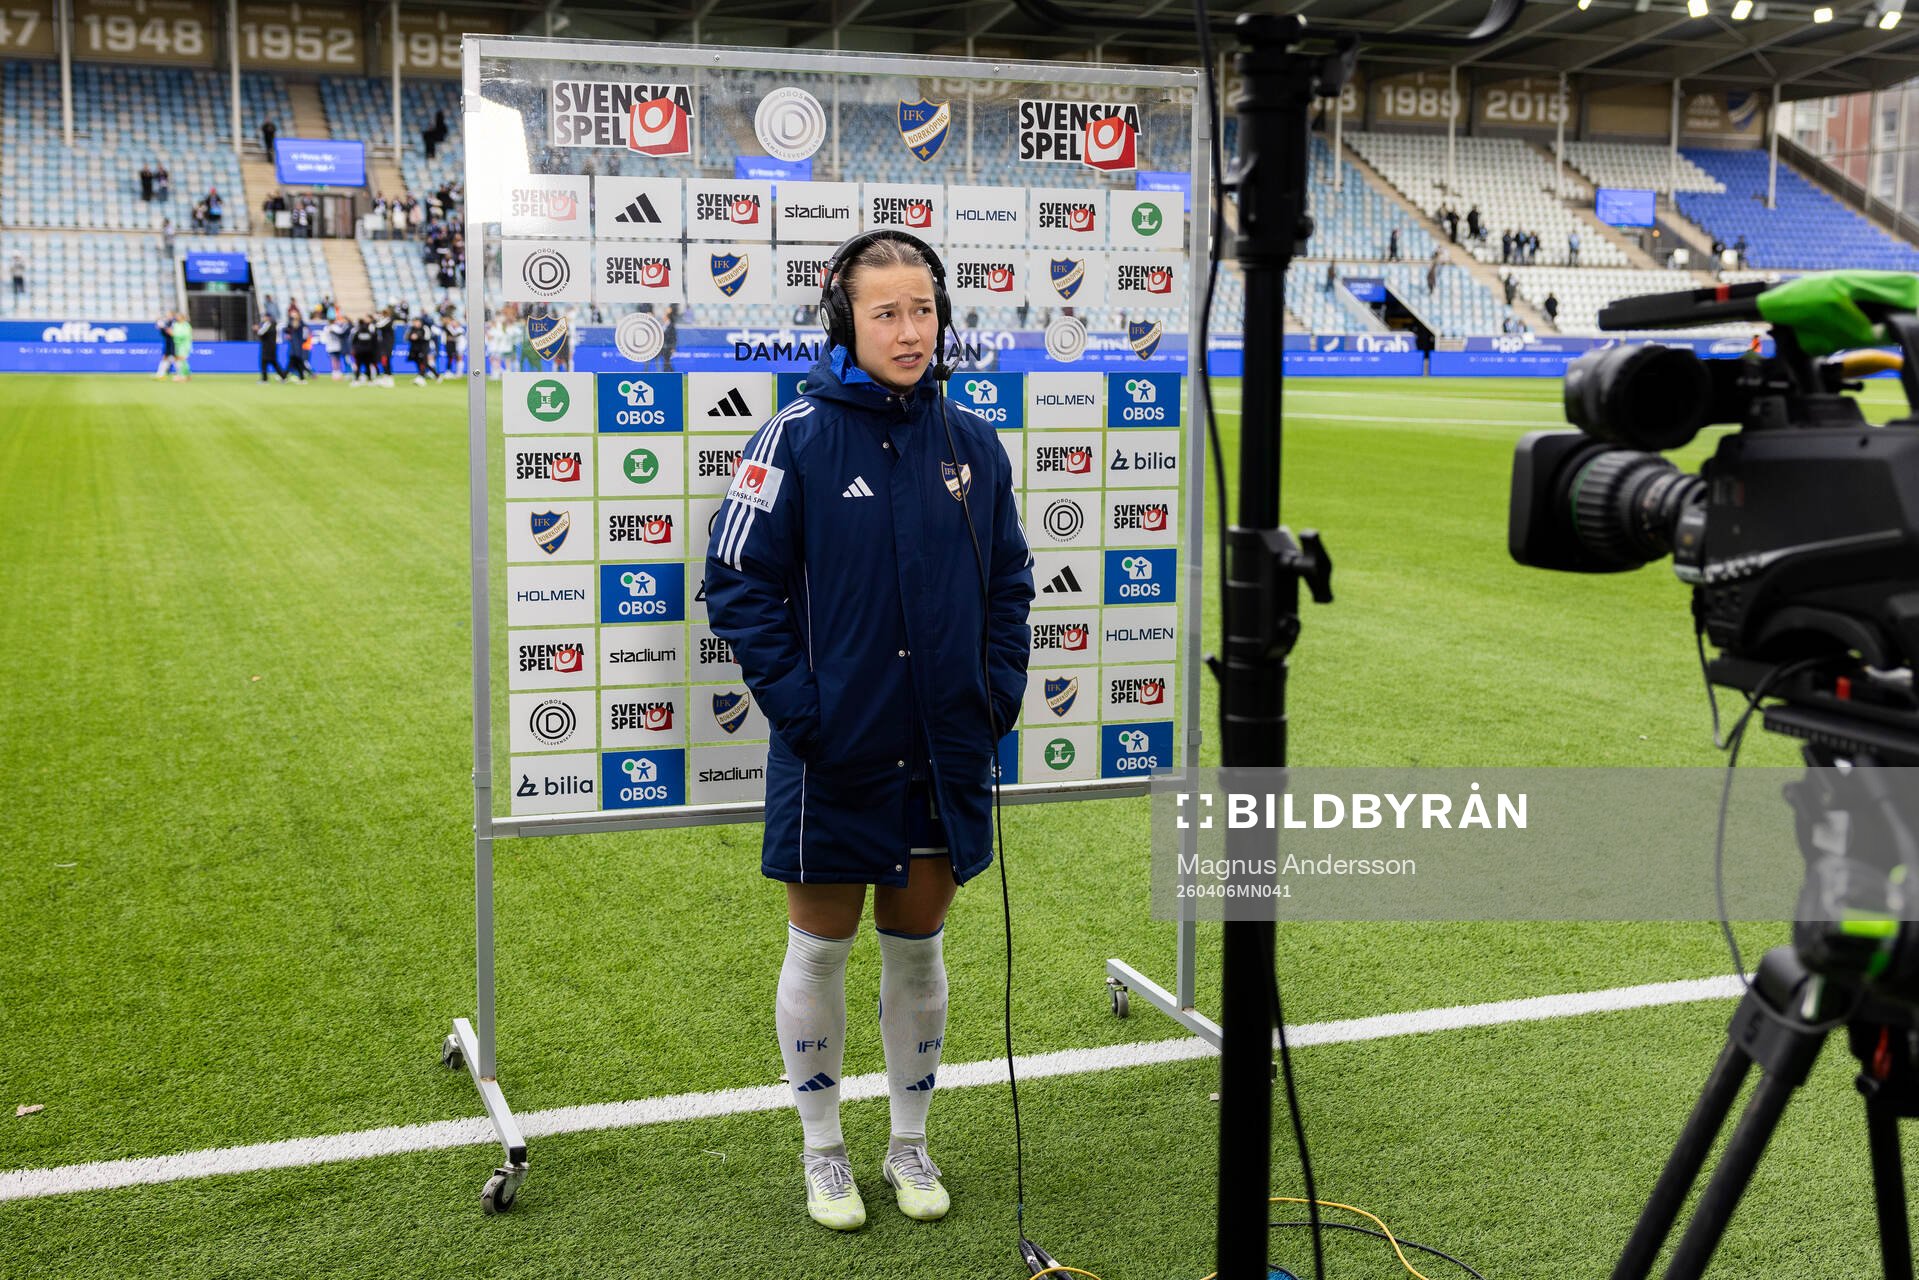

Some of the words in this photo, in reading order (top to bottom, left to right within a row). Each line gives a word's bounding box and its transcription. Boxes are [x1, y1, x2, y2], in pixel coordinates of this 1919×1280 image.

[82, 13, 203, 55] 1948
[240, 22, 357, 64] 1952
[1382, 84, 1460, 118] 1989
[1486, 85, 1570, 123] 2015
[903, 109, 925, 122] IFK
[555, 114, 627, 146] SPEL
[907, 111, 948, 145] NORRKÖPING
[1020, 131, 1082, 161] SPEL
[511, 202, 547, 218] SPEL
[696, 206, 730, 221] SPEL
[784, 204, 849, 219] stadium
[873, 210, 904, 225] SPEL
[955, 209, 1017, 222] HOLMEN
[1038, 215, 1069, 229] SPEL
[713, 259, 730, 269] IFK
[606, 270, 640, 285] SPEL
[786, 273, 819, 287] SPEL
[957, 275, 987, 289] SPEL
[1117, 277, 1146, 291] SPEL
[1036, 394, 1095, 406] HOLMEN
[616, 410, 665, 425] OBOS
[974, 407, 1007, 422] BOS
[1122, 406, 1165, 421] OBOS
[1036, 459, 1066, 472] SPEL
[1134, 451, 1176, 471] bilia
[516, 465, 551, 480] SPEL
[698, 463, 731, 477] SPEL
[752, 496, 770, 508] SPEL
[534, 517, 551, 527] IFK
[1114, 516, 1142, 530] SPEL
[609, 527, 643, 542] SPEL
[517, 588, 585, 602] HOLMEN
[1119, 583, 1161, 598] OBOS
[618, 600, 667, 616] OBOS
[1106, 627, 1174, 642] HOLMEN
[1033, 636, 1062, 650] SPEL
[609, 647, 676, 664] stadium
[700, 650, 732, 664] SPEL
[519, 657, 553, 672] SPEL
[1111, 691, 1139, 704] SPEL
[611, 715, 644, 730] SPEL
[1116, 755, 1158, 771] OBOS
[698, 766, 763, 783] stadium
[544, 776, 594, 796] bilia
[619, 785, 668, 802] OBOS
[796, 1037, 828, 1053] IFK
[918, 1036, 943, 1054] IFK
